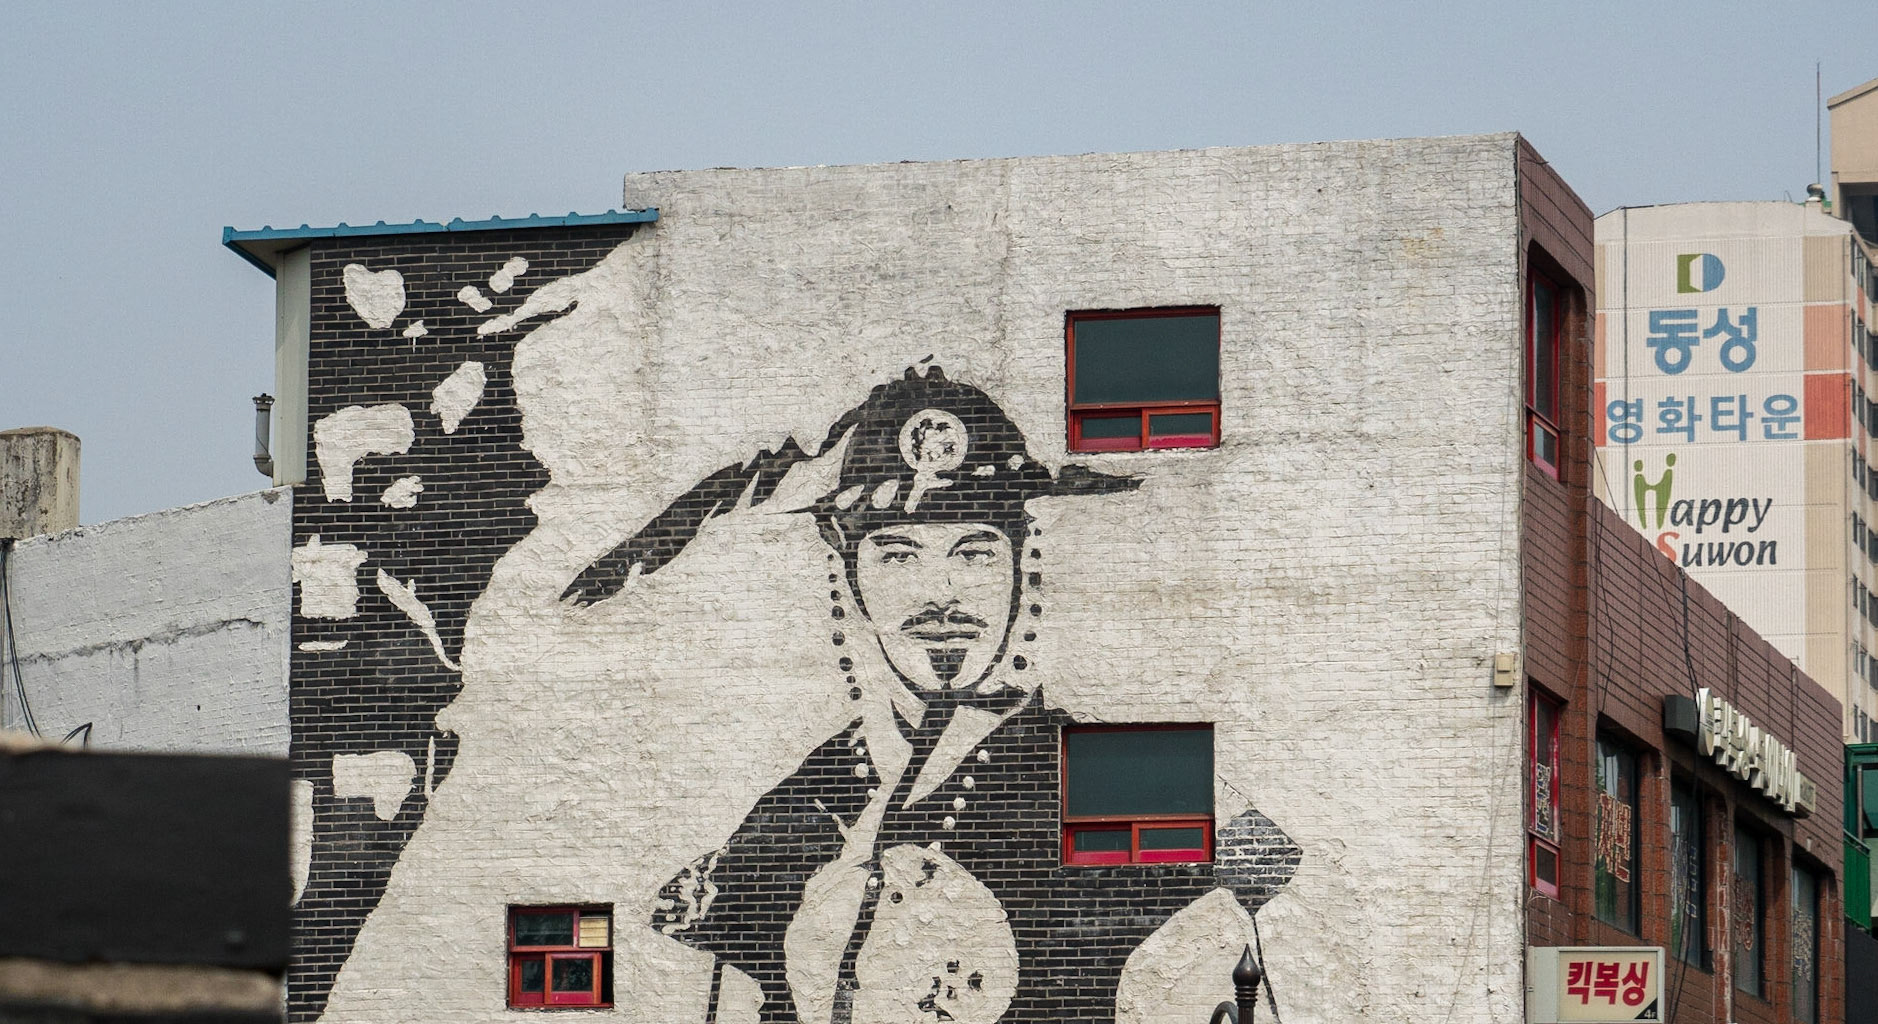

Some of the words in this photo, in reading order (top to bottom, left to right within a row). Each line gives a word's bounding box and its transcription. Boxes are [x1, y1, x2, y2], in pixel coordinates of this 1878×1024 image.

[1646, 307, 1758, 375] 동성
[1606, 394, 1800, 444] 영화타운
[1633, 453, 1773, 533] Happy
[1656, 531, 1778, 567] Suwon
[1567, 961, 1649, 1006] 킥복싱
[1644, 1009, 1656, 1019] 4F
